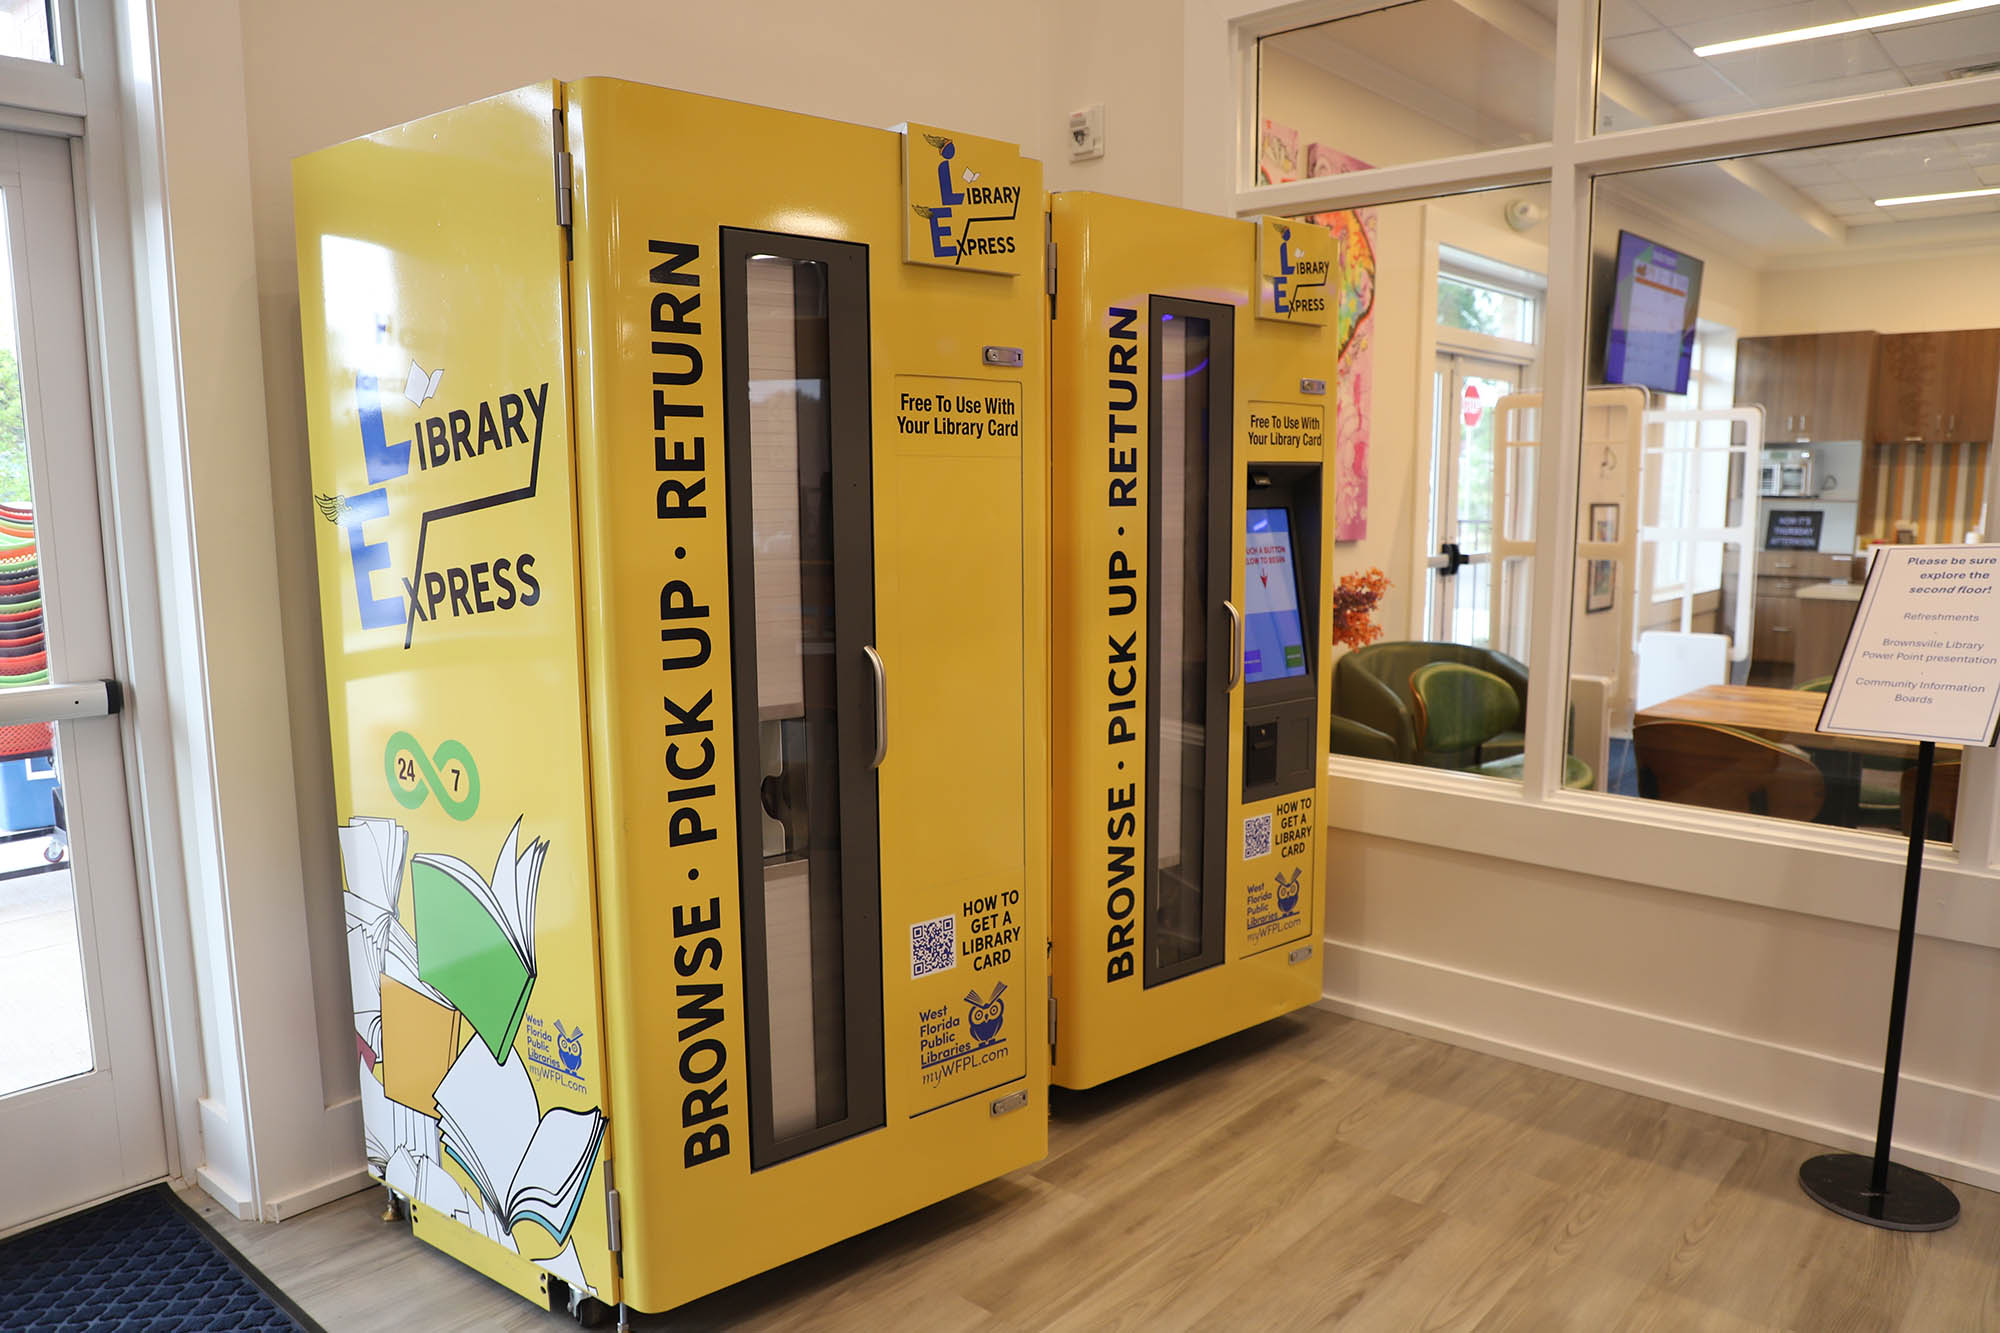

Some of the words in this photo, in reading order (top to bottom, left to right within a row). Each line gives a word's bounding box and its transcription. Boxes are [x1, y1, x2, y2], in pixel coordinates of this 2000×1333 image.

[938, 158, 1020, 207] LIBRARY
[930, 207, 1016, 264] EXPRESS
[648, 239, 707, 519] RETURN
[900, 393, 932, 412] Free
[936, 395, 951, 413] To
[956, 396, 982, 414] Use
[985, 397, 1015, 416] With
[1108, 307, 1138, 507] RETURN
[897, 416, 930, 435] Your
[934, 417, 984, 439] Library
[988, 419, 1018, 437] Card
[1250, 415, 1270, 429] Free
[1272, 415, 1282, 429] To
[1283, 416, 1299, 430] Use
[1301, 416, 1320, 430] With
[1248, 432, 1268, 445] Your
[1270, 432, 1300, 448] Library
[1302, 433, 1322, 446] Card
[1907, 556, 1948, 565] Please
[1950, 556, 1966, 565] be
[1969, 557, 1997, 565] sure
[1108, 550, 1137, 616] UP
[1919, 571, 1966, 581] explore
[1969, 571, 1990, 580] the
[1909, 586, 1955, 594] second
[1957, 586, 1992, 594] floor!
[660, 580, 712, 670] UP
[1903, 612, 1980, 622] Refreshments
[1882, 638, 1944, 649] Brownsville
[1945, 641, 1985, 651] Library
[1862, 651, 1894, 660] Power
[1896, 652, 1924, 661] Point
[1925, 654, 1997, 665] presentation
[1108, 631, 1137, 744] PICK
[1855, 677, 1918, 689] Community
[1919, 681, 1985, 693] Information
[1894, 694, 1933, 704] Boards
[397, 757, 416, 782] 24
[451, 768, 461, 791] 7
[663, 688, 717, 847] PICK
[1276, 801, 1299, 816] HOW
[1300, 797, 1312, 809] TO
[1281, 815, 1299, 829] GET
[1300, 813, 1307, 824] A
[1275, 826, 1312, 846] LIBRARY
[1281, 842, 1305, 858] CARD
[1107, 783, 1136, 983] BROWSE
[1247, 883, 1265, 894] West
[963, 895, 998, 917] HOW
[1001, 889, 1019, 907] TO
[1247, 904, 1269, 916] Public
[971, 913, 999, 934] GET
[1002, 910, 1012, 926] A
[962, 926, 1021, 956] LIBRARY
[973, 949, 1011, 972] CARD
[526, 1012, 543, 1027] West
[919, 1005, 947, 1022] West
[526, 1024, 552, 1042] Florida
[672, 897, 731, 1169] BROWSE
[920, 1016, 960, 1038] Florida
[527, 1036, 550, 1053] Public
[920, 1033, 956, 1051] Public
[528, 1047, 560, 1068] Libraries
[920, 1041, 971, 1066] Libraries
[922, 1046, 1009, 1088] myWFPL.com
[529, 1065, 587, 1094] myWFPL.com
